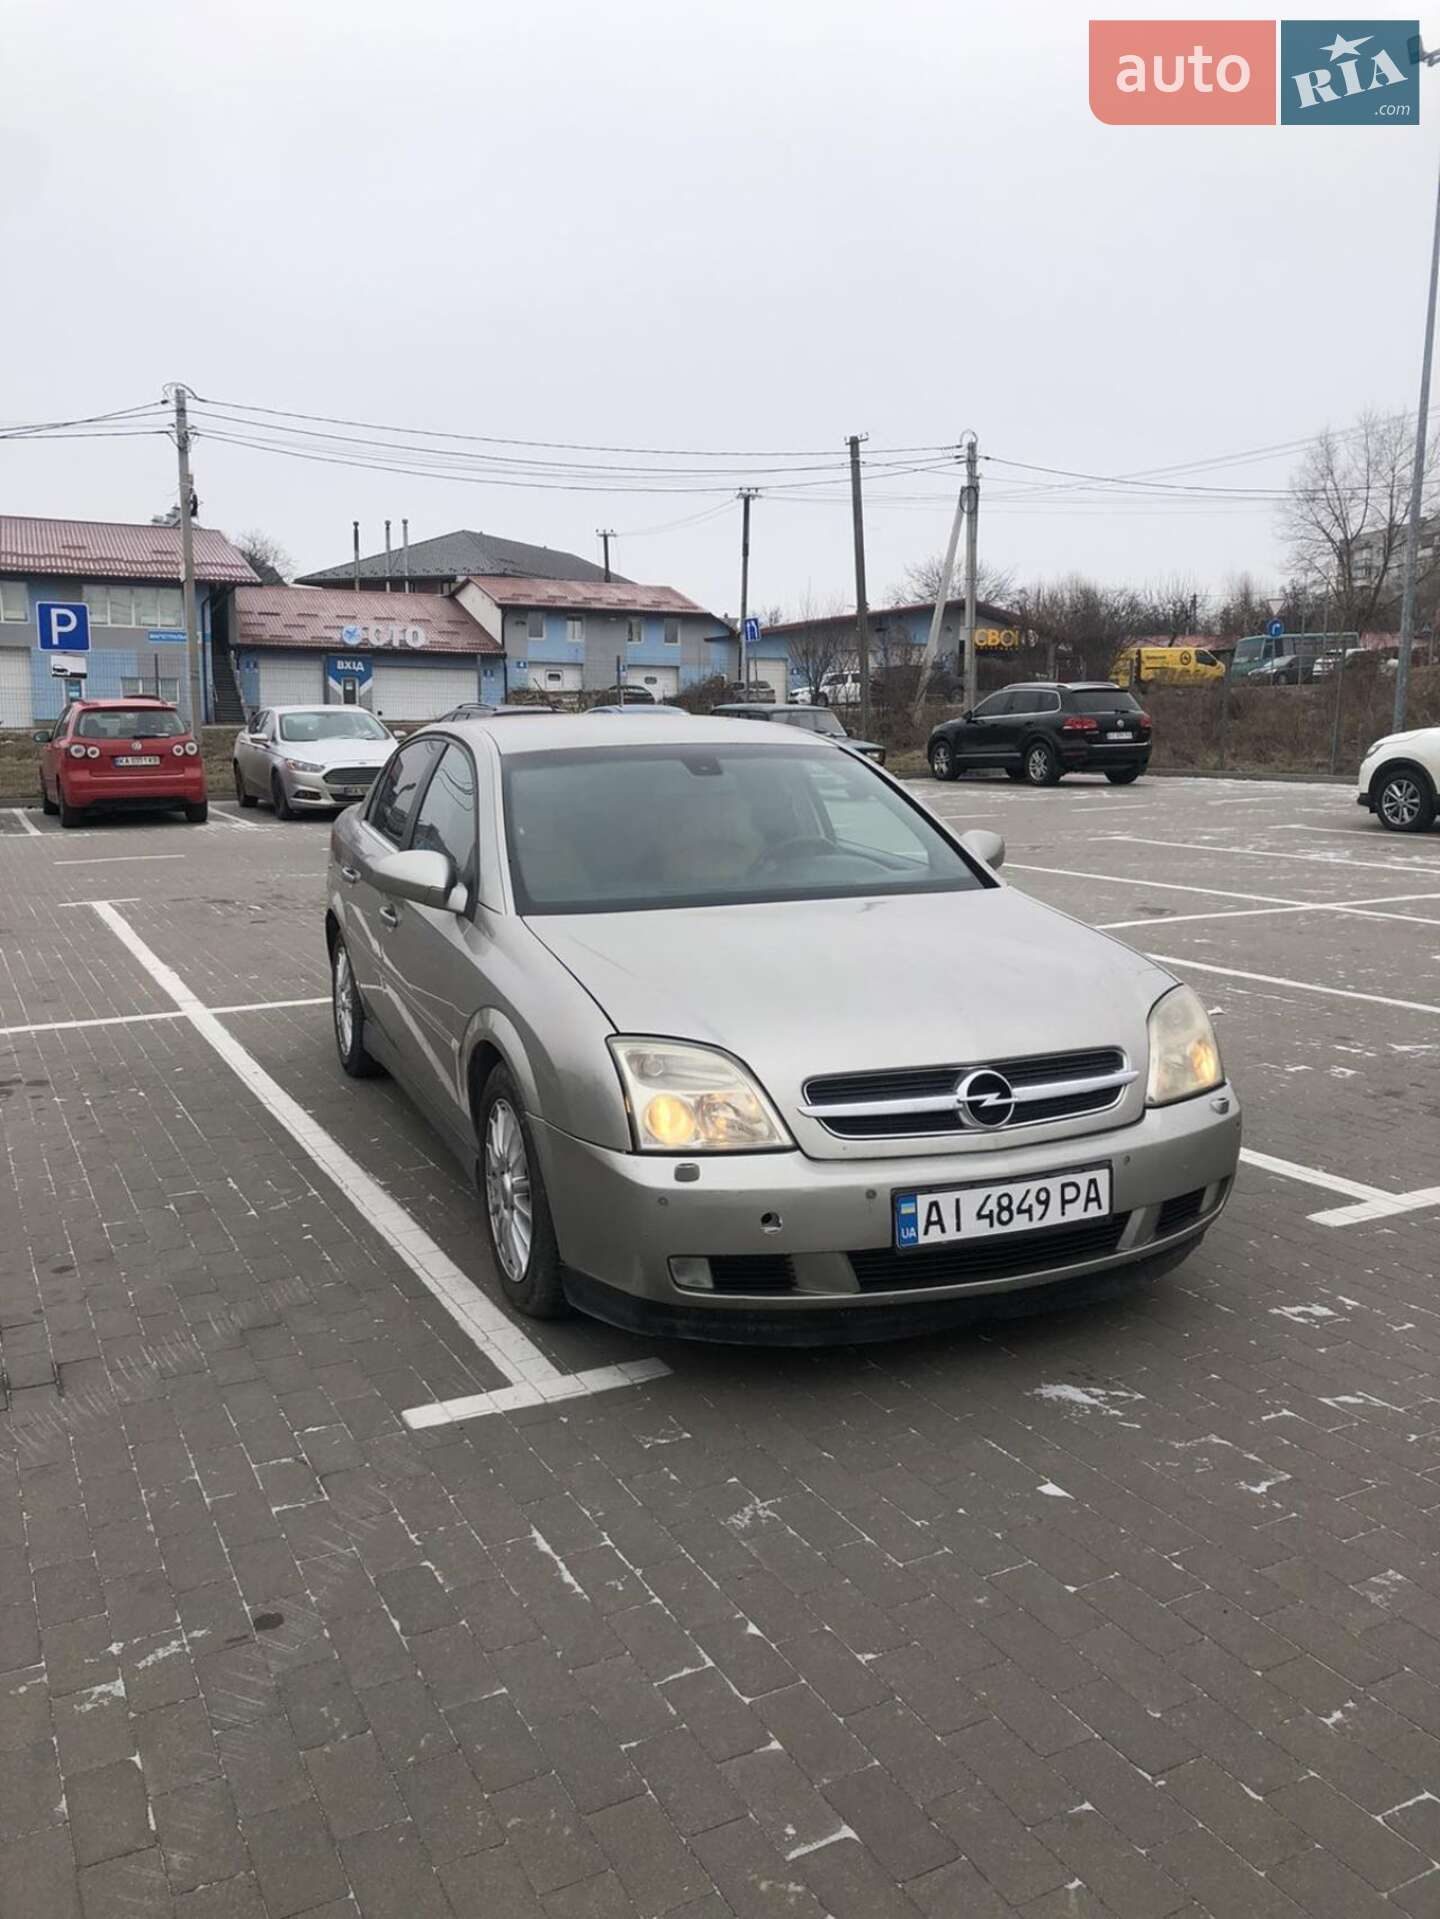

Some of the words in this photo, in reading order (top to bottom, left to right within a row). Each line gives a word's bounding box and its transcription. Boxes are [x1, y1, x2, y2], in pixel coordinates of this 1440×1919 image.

[51, 609, 77, 645] P
[367, 624, 426, 647] СТО
[336, 660, 365, 672] ВХІД
[923, 1197, 961, 1236] AI
[976, 1186, 1051, 1229] 4849
[1060, 1177, 1103, 1217] PA
[901, 1227, 918, 1239] UA
